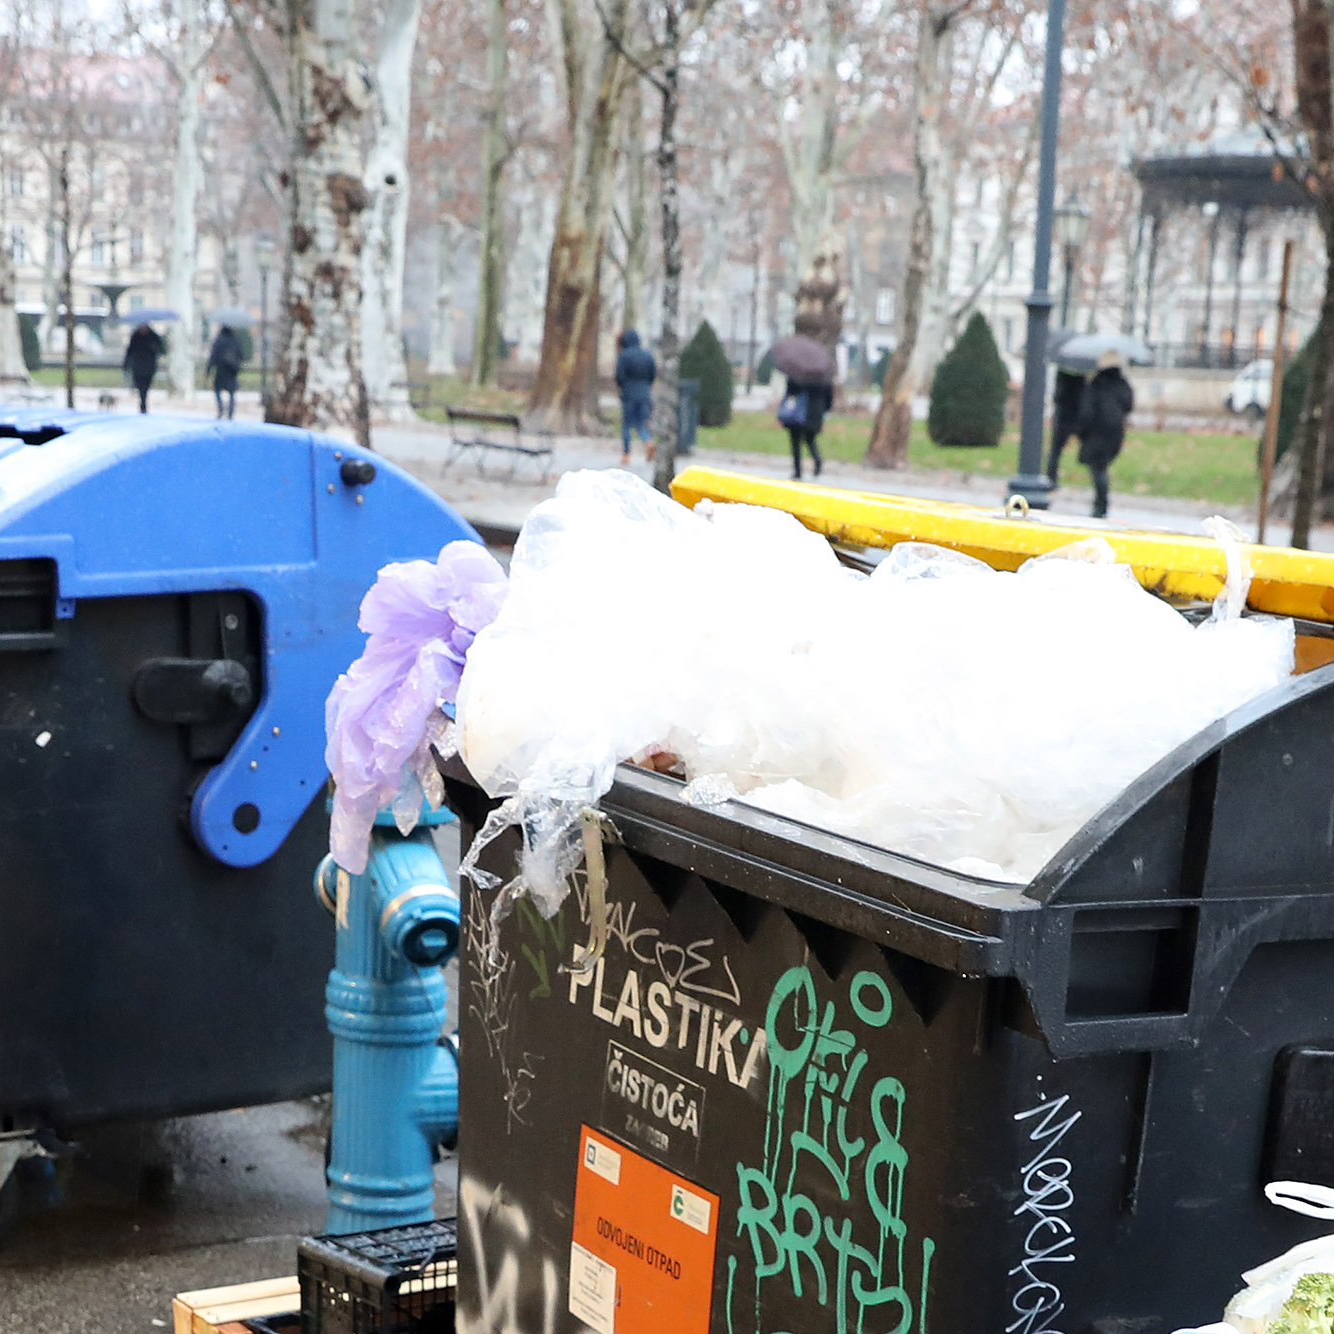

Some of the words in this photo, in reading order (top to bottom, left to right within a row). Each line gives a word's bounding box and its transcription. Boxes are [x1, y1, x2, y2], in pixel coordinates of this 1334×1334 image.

[569, 942, 767, 1090] PLASTIKA
[607, 1049, 700, 1138] ČISTOĆA
[596, 1216, 644, 1261] ODVOJENI
[647, 1246, 681, 1281] OTPAD
